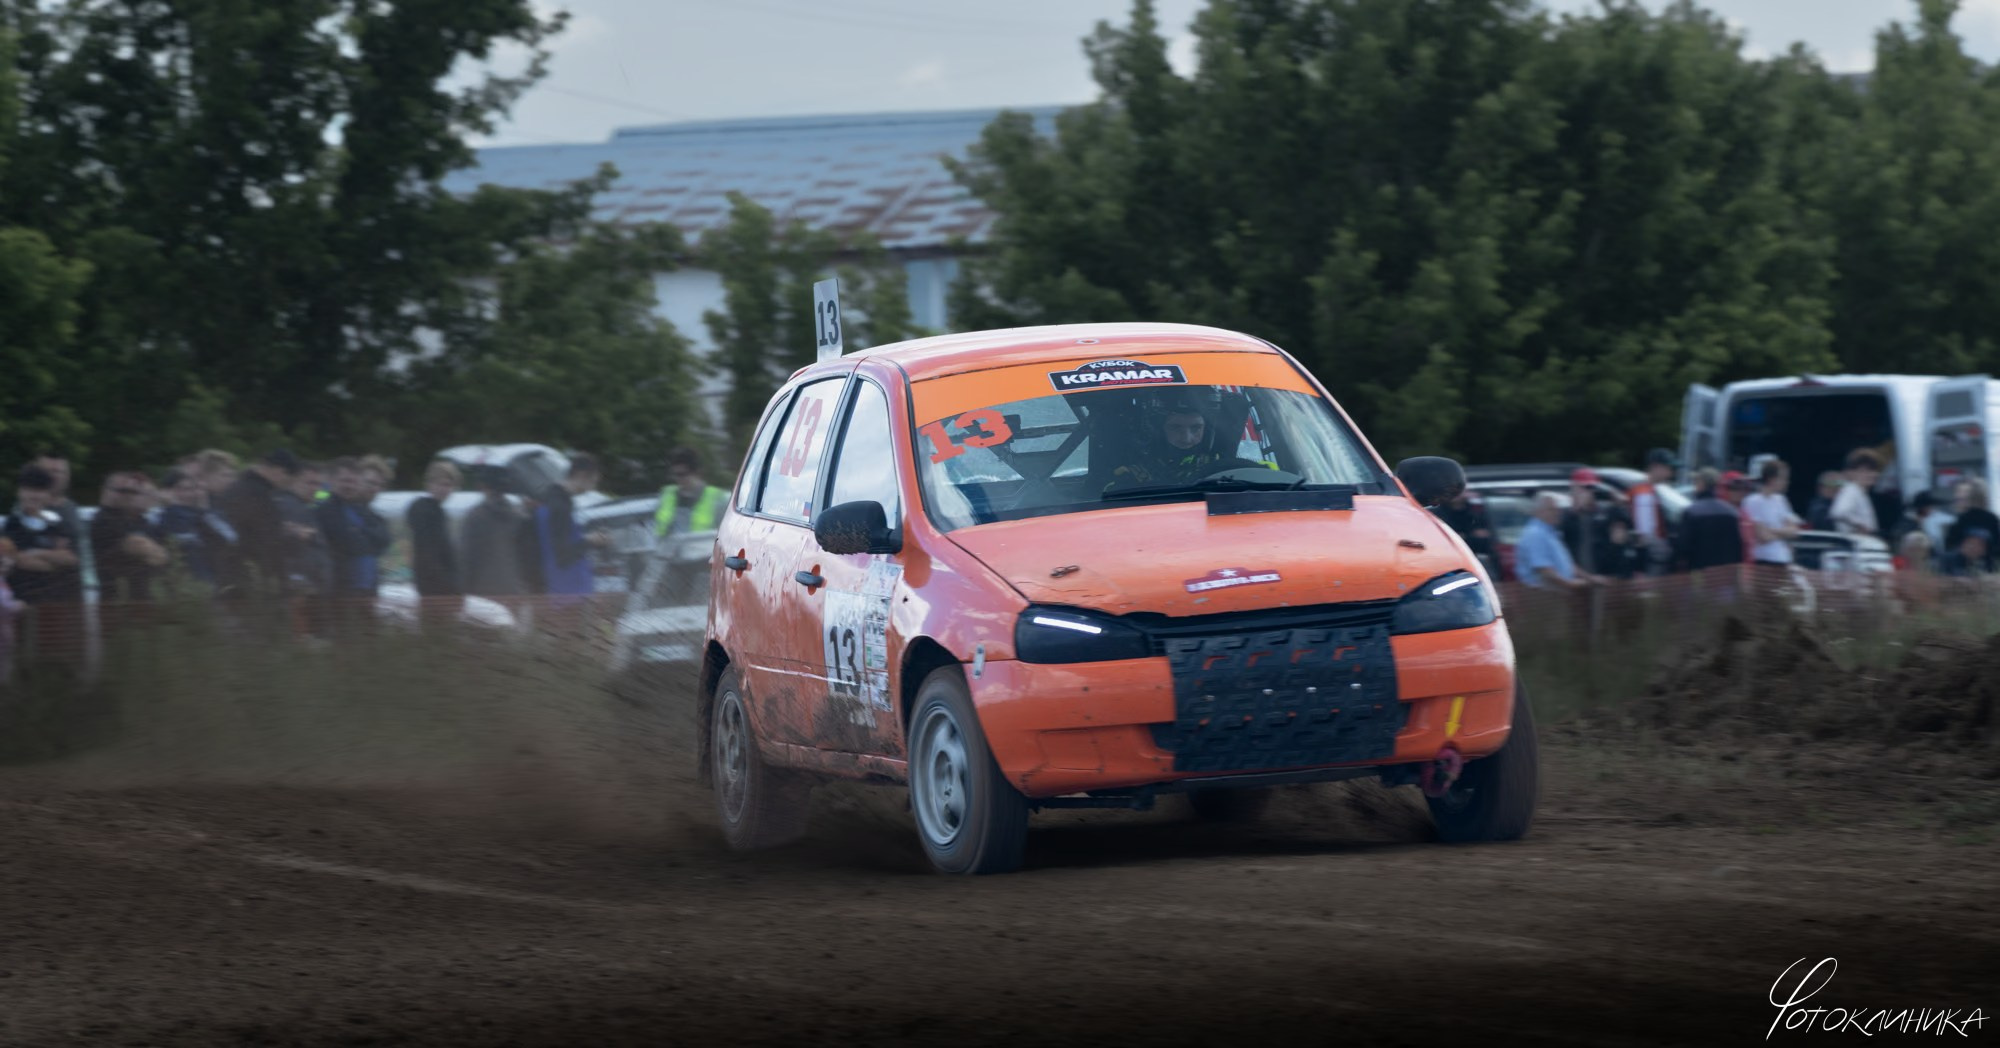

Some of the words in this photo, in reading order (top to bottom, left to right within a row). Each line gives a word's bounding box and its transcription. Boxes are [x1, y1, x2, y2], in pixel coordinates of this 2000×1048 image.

[818, 300, 839, 346] 13
[1061, 369, 1173, 385] KRAMAR
[1089, 360, 1135, 369] КУБОК
[780, 396, 823, 478] 13
[920, 409, 1013, 464] 13
[830, 625, 861, 697] 13
